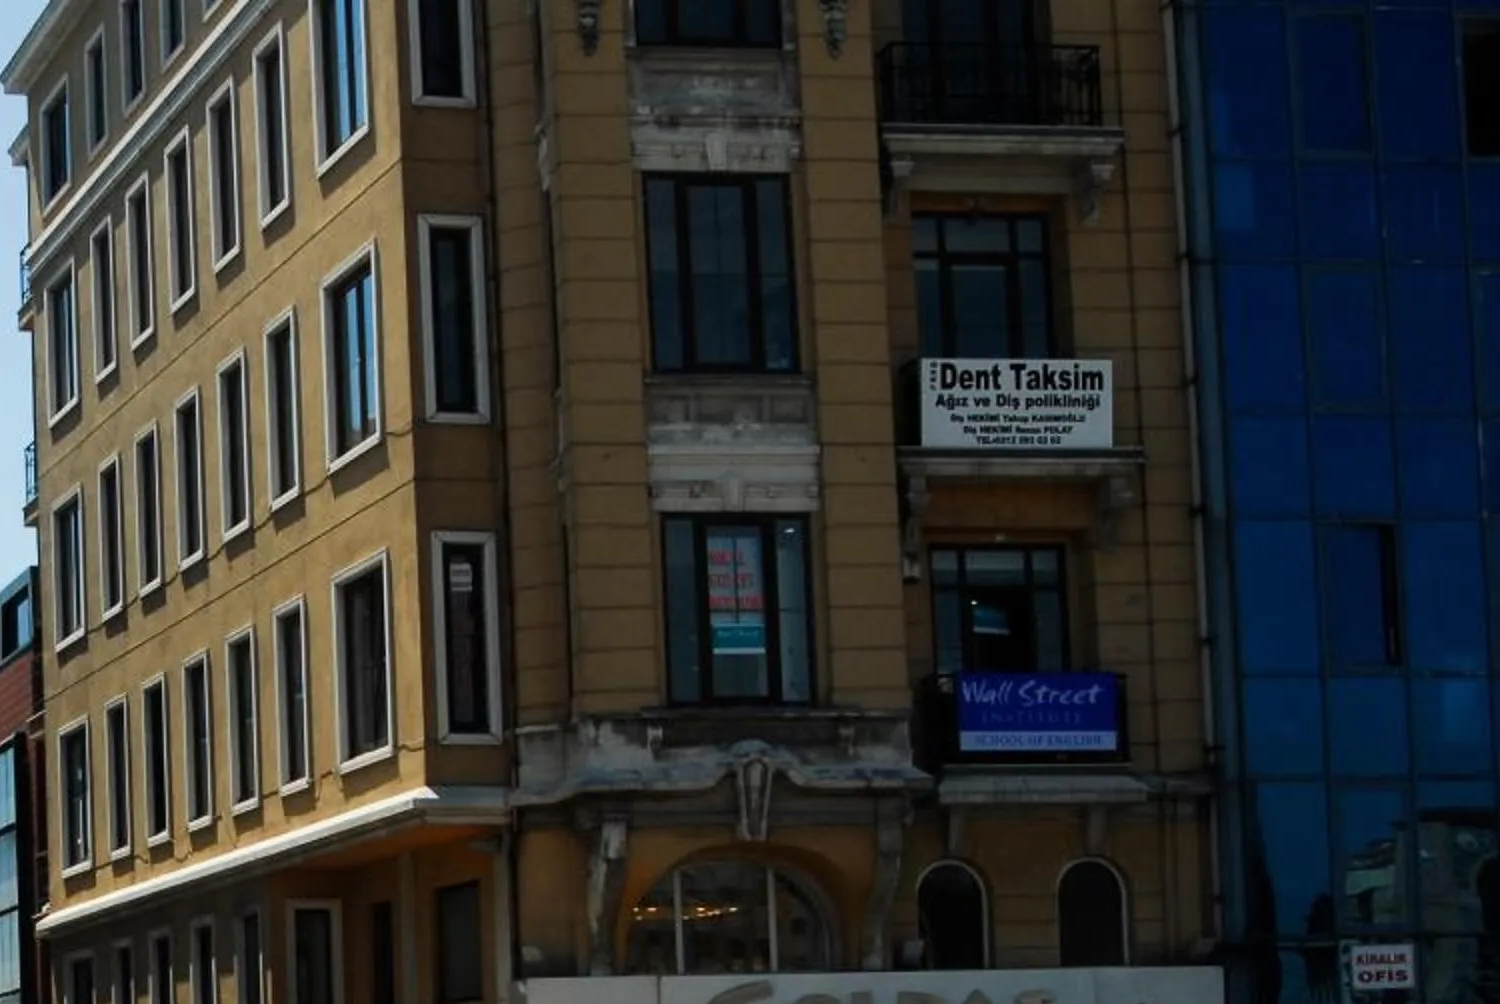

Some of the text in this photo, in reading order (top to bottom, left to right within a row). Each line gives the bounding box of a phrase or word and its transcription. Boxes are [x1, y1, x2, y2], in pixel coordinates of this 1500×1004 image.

[940, 363, 1002, 391] Dent
[1009, 363, 1104, 391] Taksim
[973, 397, 991, 407] ve
[996, 393, 1020, 410] Diş
[961, 679, 1106, 707] Wall Street
